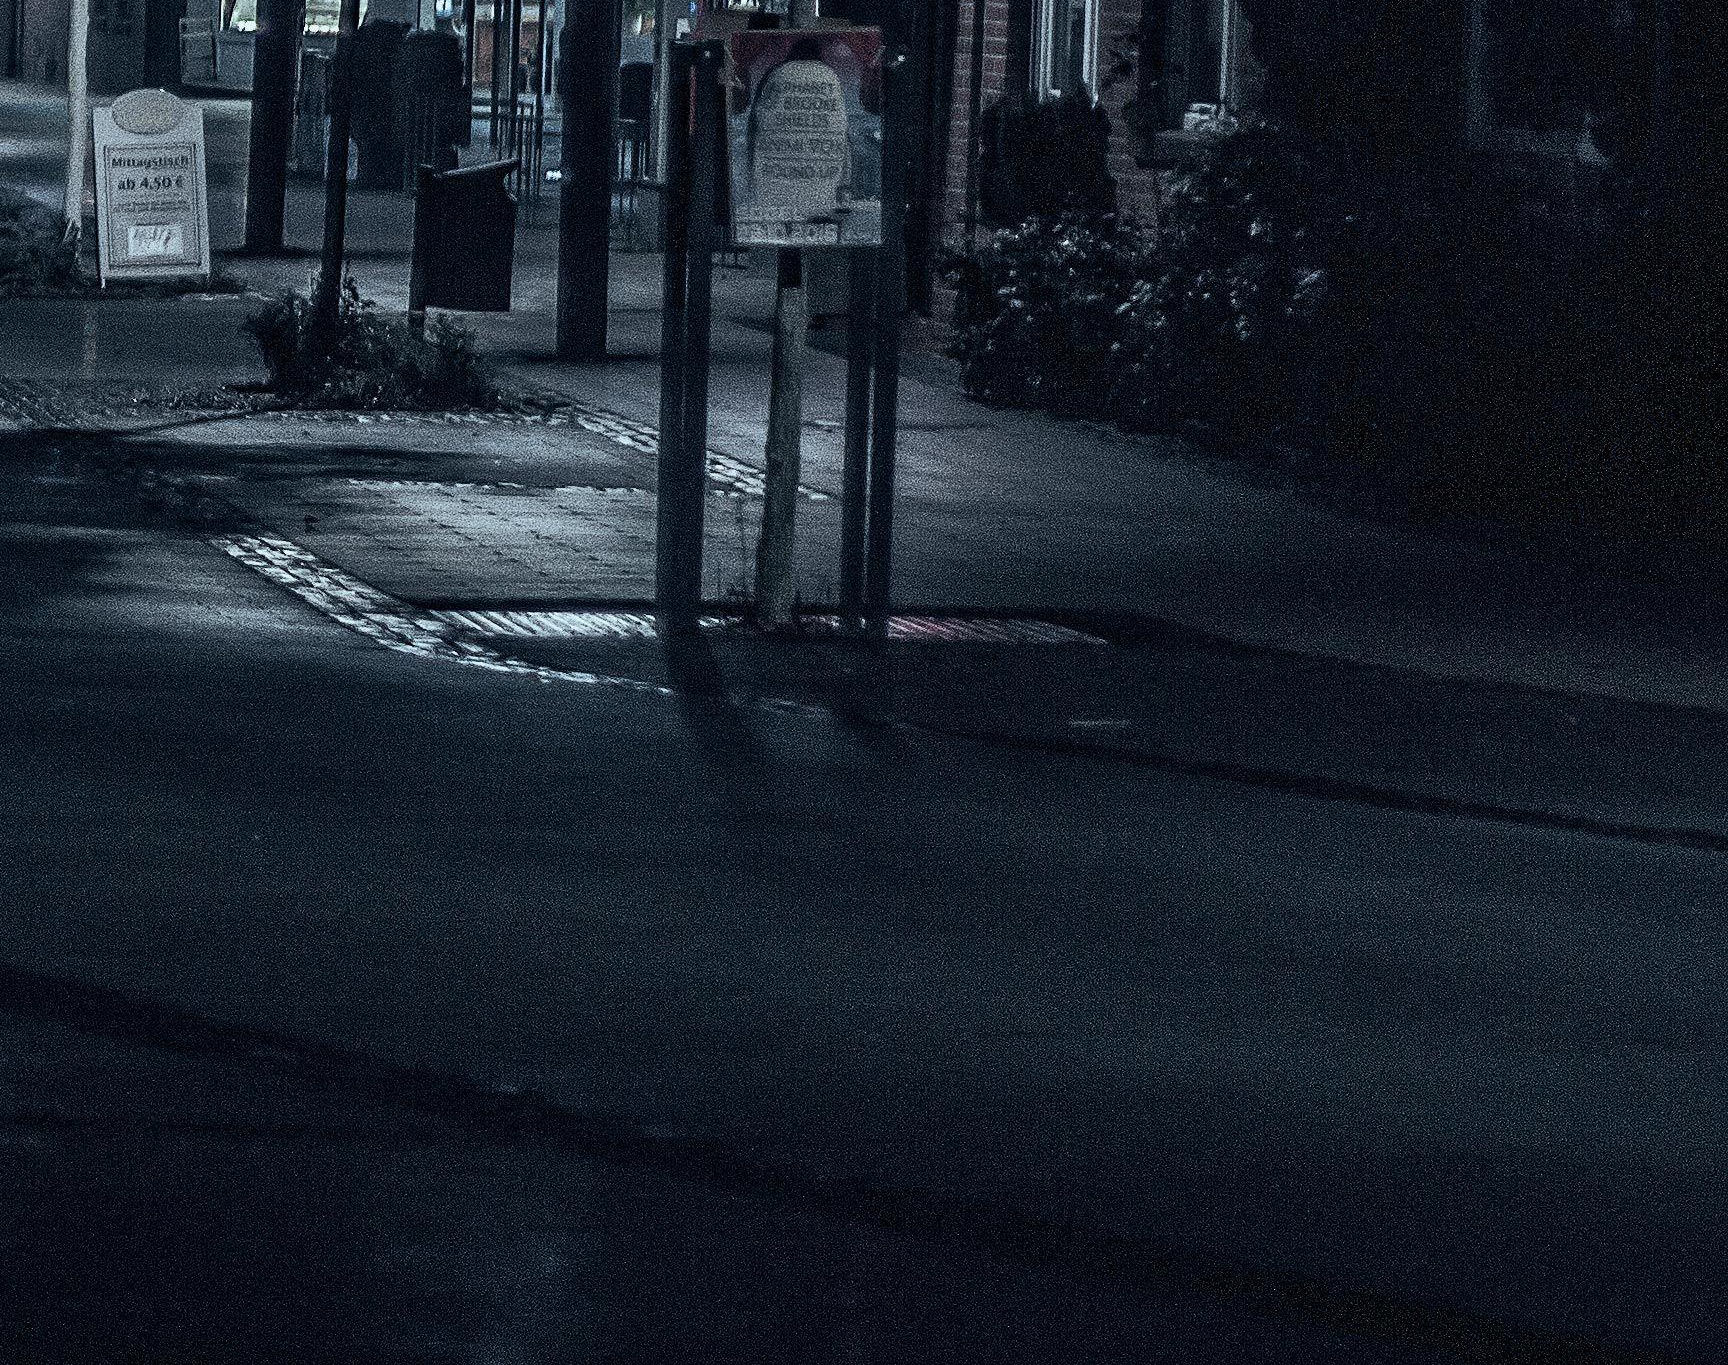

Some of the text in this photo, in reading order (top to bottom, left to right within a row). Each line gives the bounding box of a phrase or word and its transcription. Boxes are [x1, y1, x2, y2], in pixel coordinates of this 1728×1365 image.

[111, 155, 189, 170] Mittagstisch
[118, 178, 135, 190] ab
[175, 174, 184, 188] €
